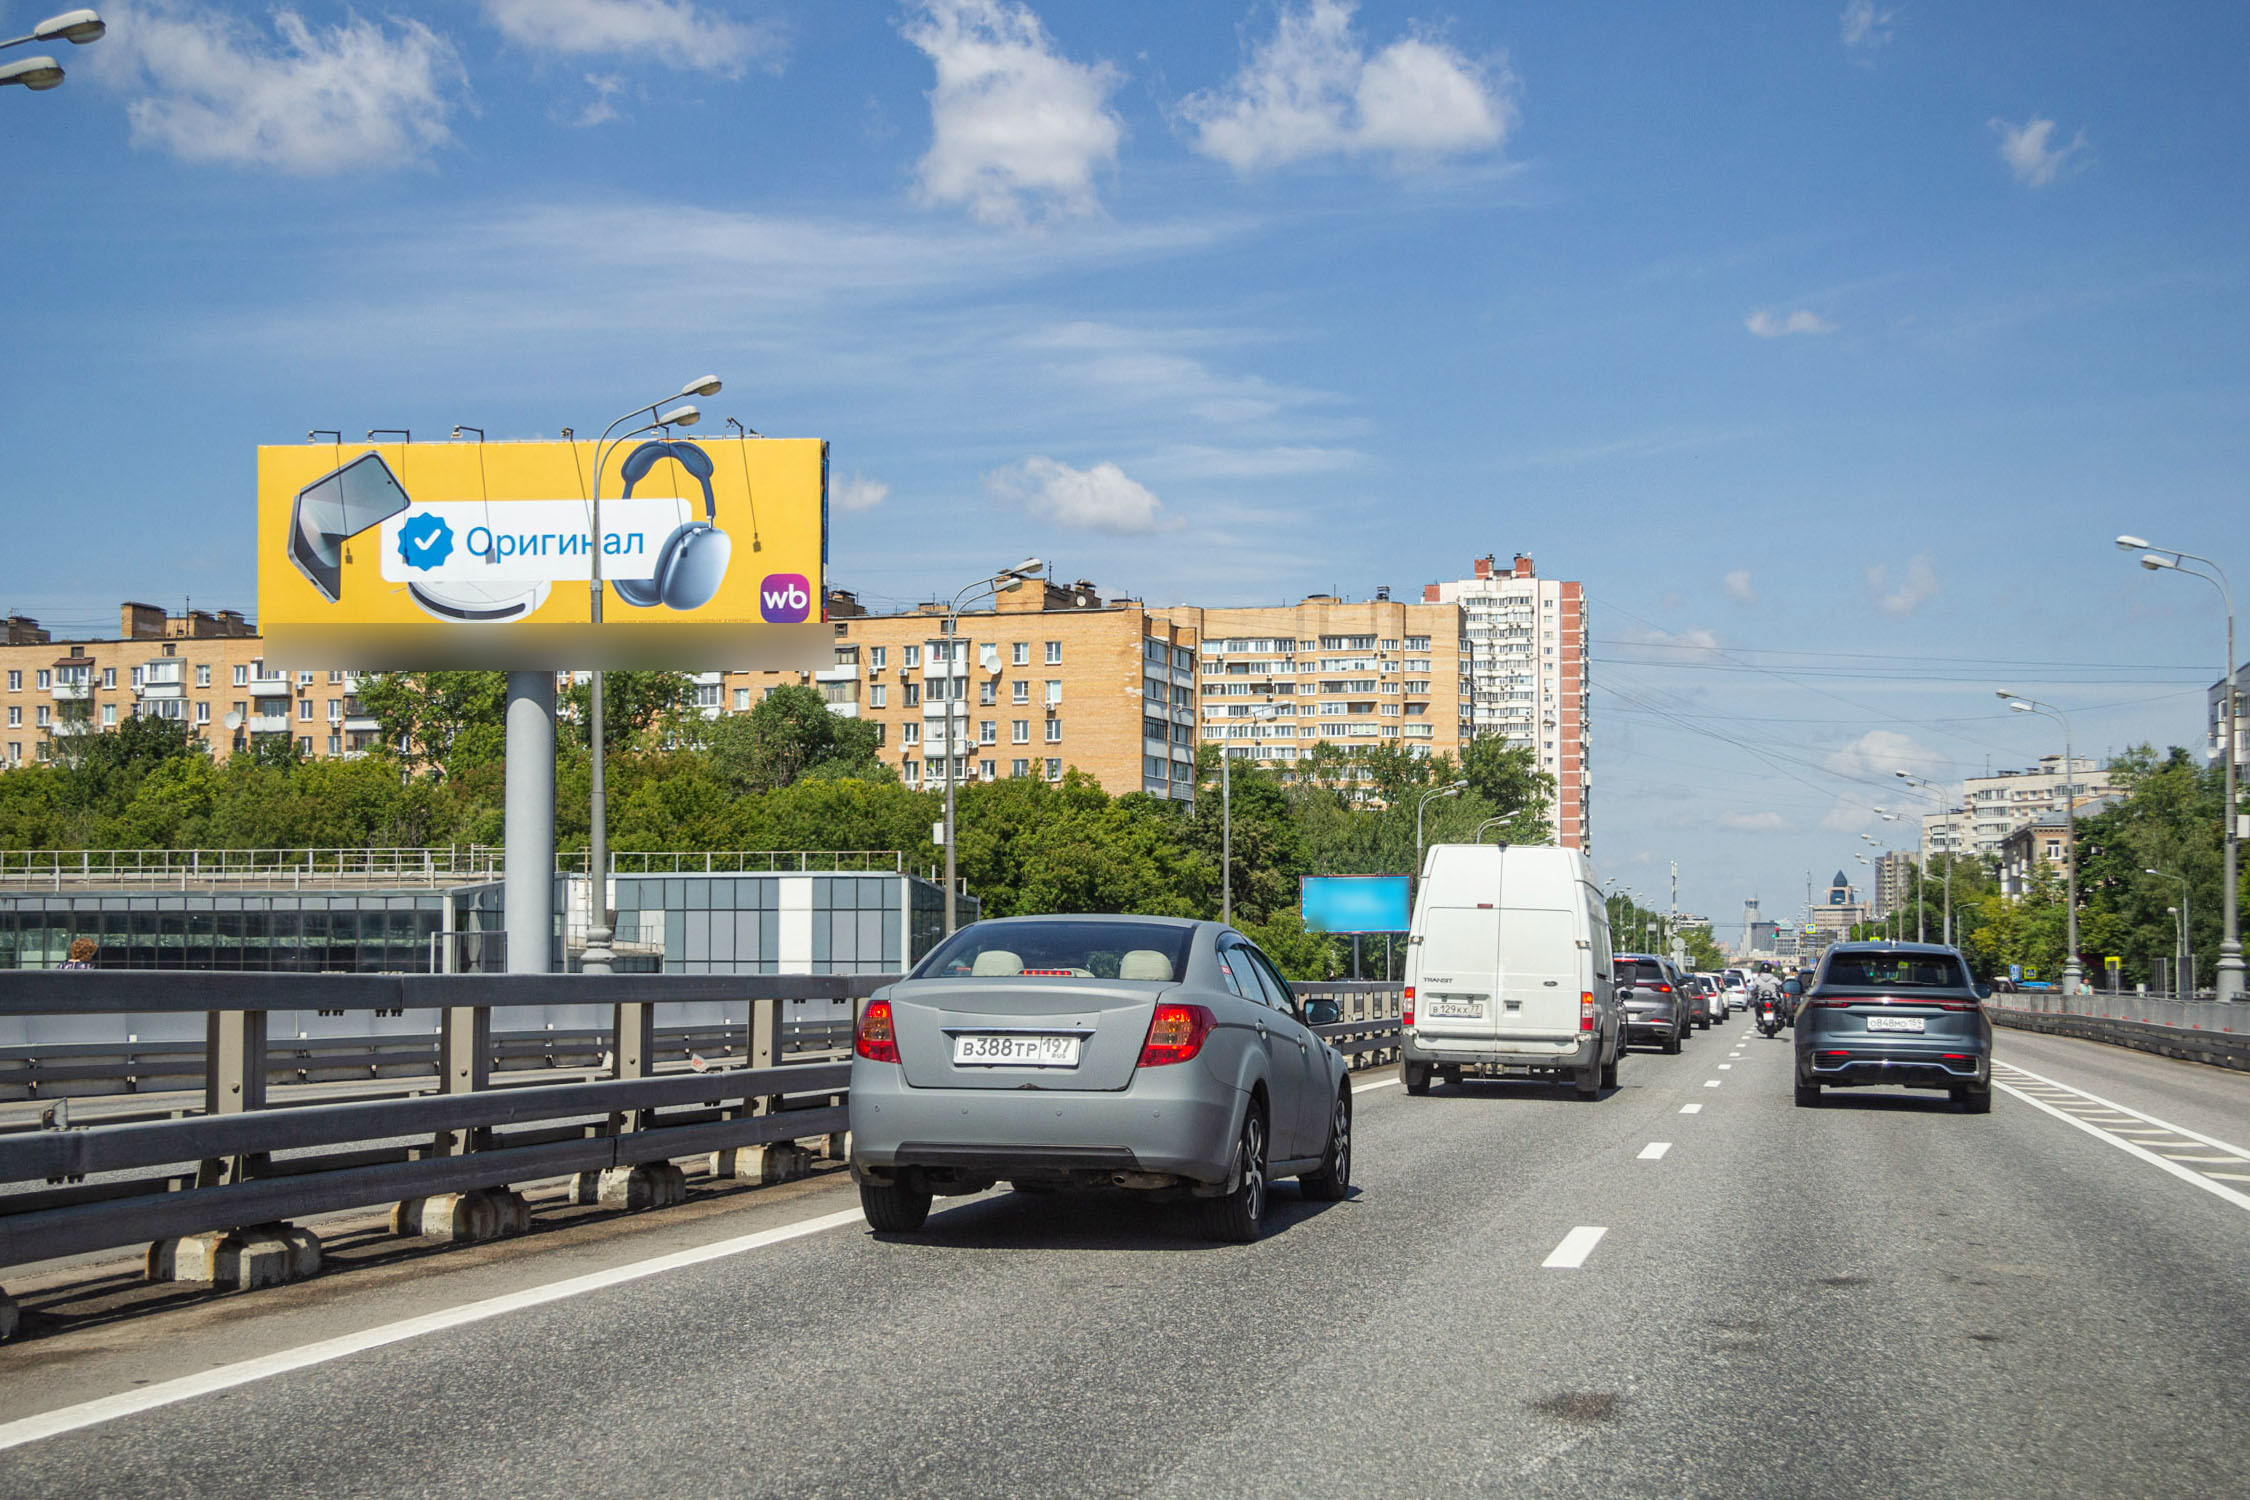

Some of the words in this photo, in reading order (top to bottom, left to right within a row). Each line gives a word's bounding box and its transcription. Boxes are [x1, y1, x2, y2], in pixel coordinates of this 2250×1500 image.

[466, 526, 644, 564] Оригинал
[763, 583, 808, 609] wb
[963, 1038, 1038, 1057] В388ТР
[1043, 1037, 1073, 1054] 197
